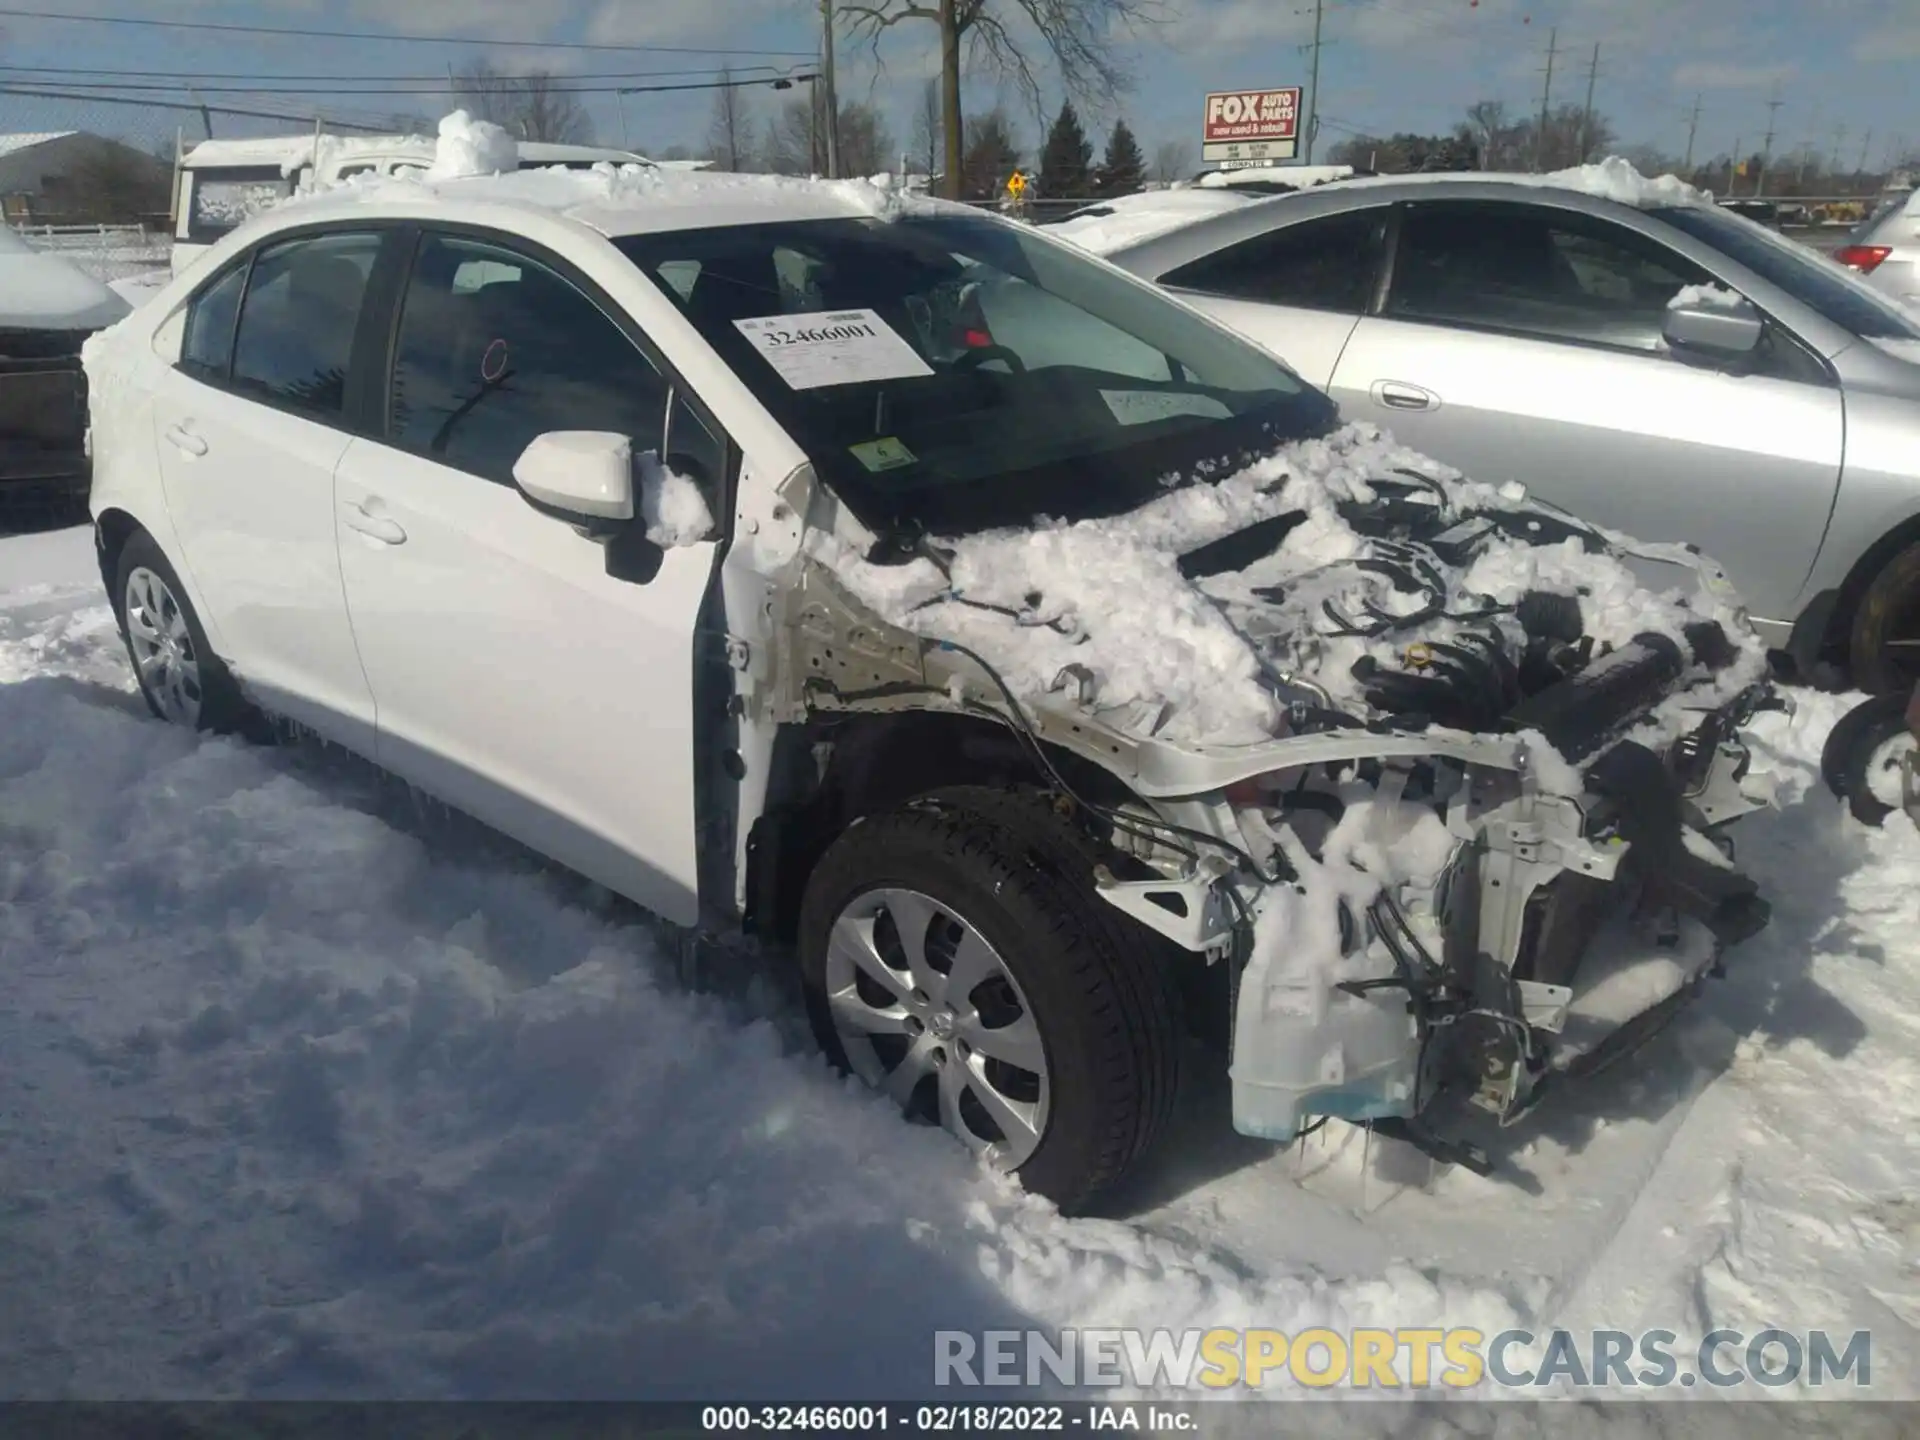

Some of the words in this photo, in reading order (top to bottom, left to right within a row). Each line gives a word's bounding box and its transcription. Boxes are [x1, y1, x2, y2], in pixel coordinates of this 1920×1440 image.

[1262, 92, 1292, 106] AUTO
[1209, 95, 1259, 124] FOX
[1260, 106, 1293, 120] PARTS
[1231, 124, 1251, 135] used
[763, 323, 877, 346] 32466001
